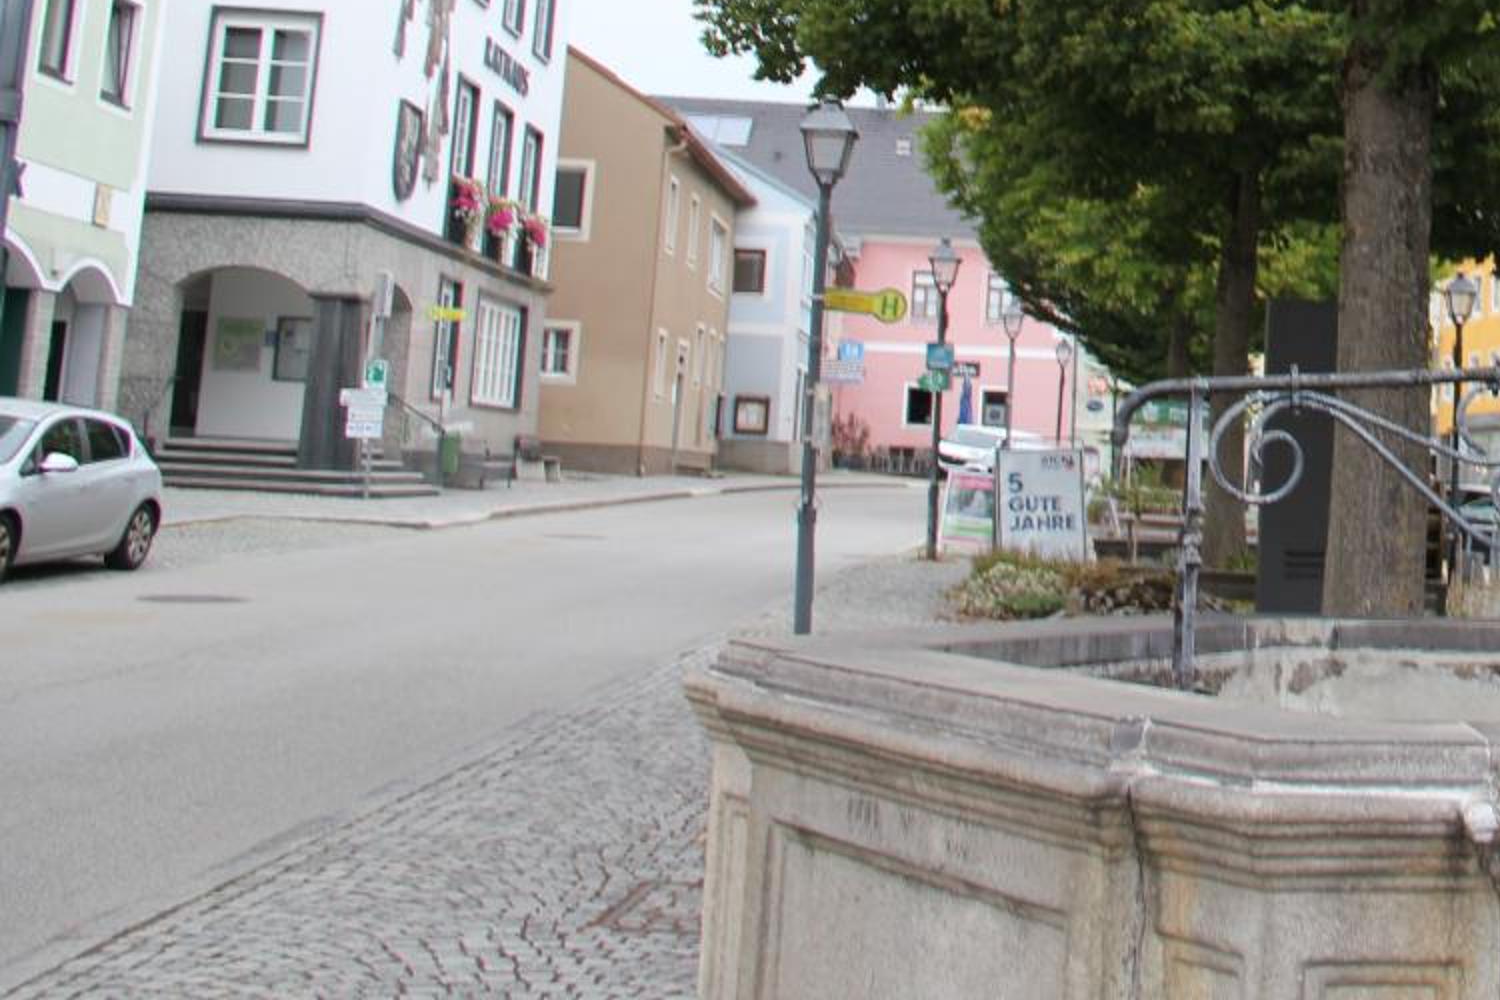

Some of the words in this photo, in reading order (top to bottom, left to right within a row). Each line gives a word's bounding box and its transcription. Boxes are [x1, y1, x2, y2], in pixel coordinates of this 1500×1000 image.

[881, 295, 898, 317] H
[1008, 473, 1023, 493] 5
[1008, 494, 1062, 513] GUTE
[1008, 514, 1076, 532] JAHRE
